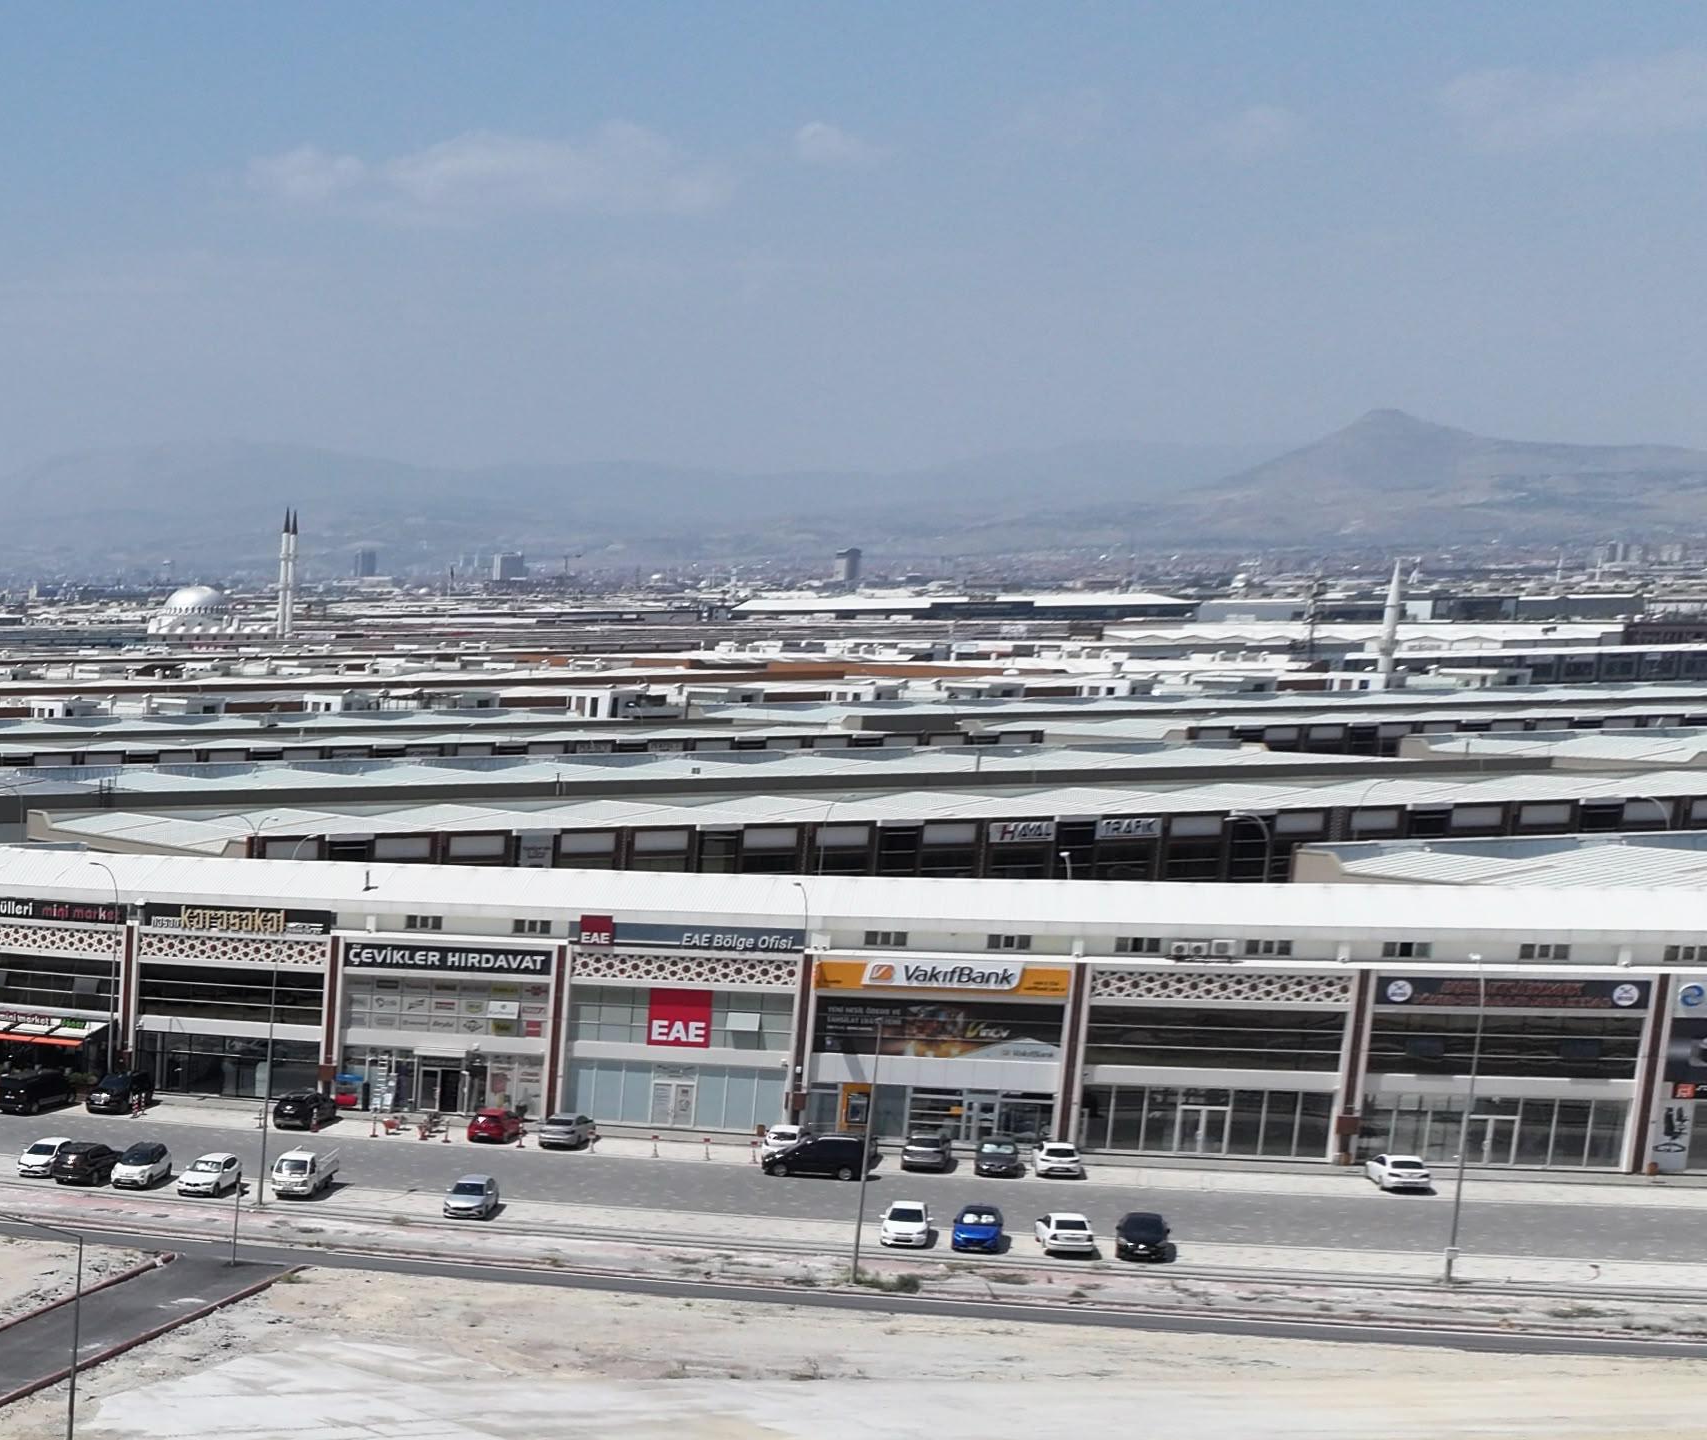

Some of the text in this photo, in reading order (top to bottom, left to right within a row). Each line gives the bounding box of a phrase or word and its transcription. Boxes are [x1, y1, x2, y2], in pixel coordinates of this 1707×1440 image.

[42, 904, 69, 919] mini
[181, 905, 285, 933] karasakal
[581, 931, 611, 945] EAE
[681, 933, 794, 951] EAE Bölge Ofisi
[349, 947, 546, 970] ÇEVİKLER HIRDAVAT
[903, 965, 1016, 985] VakıfBank
[651, 1020, 706, 1042] EAE
